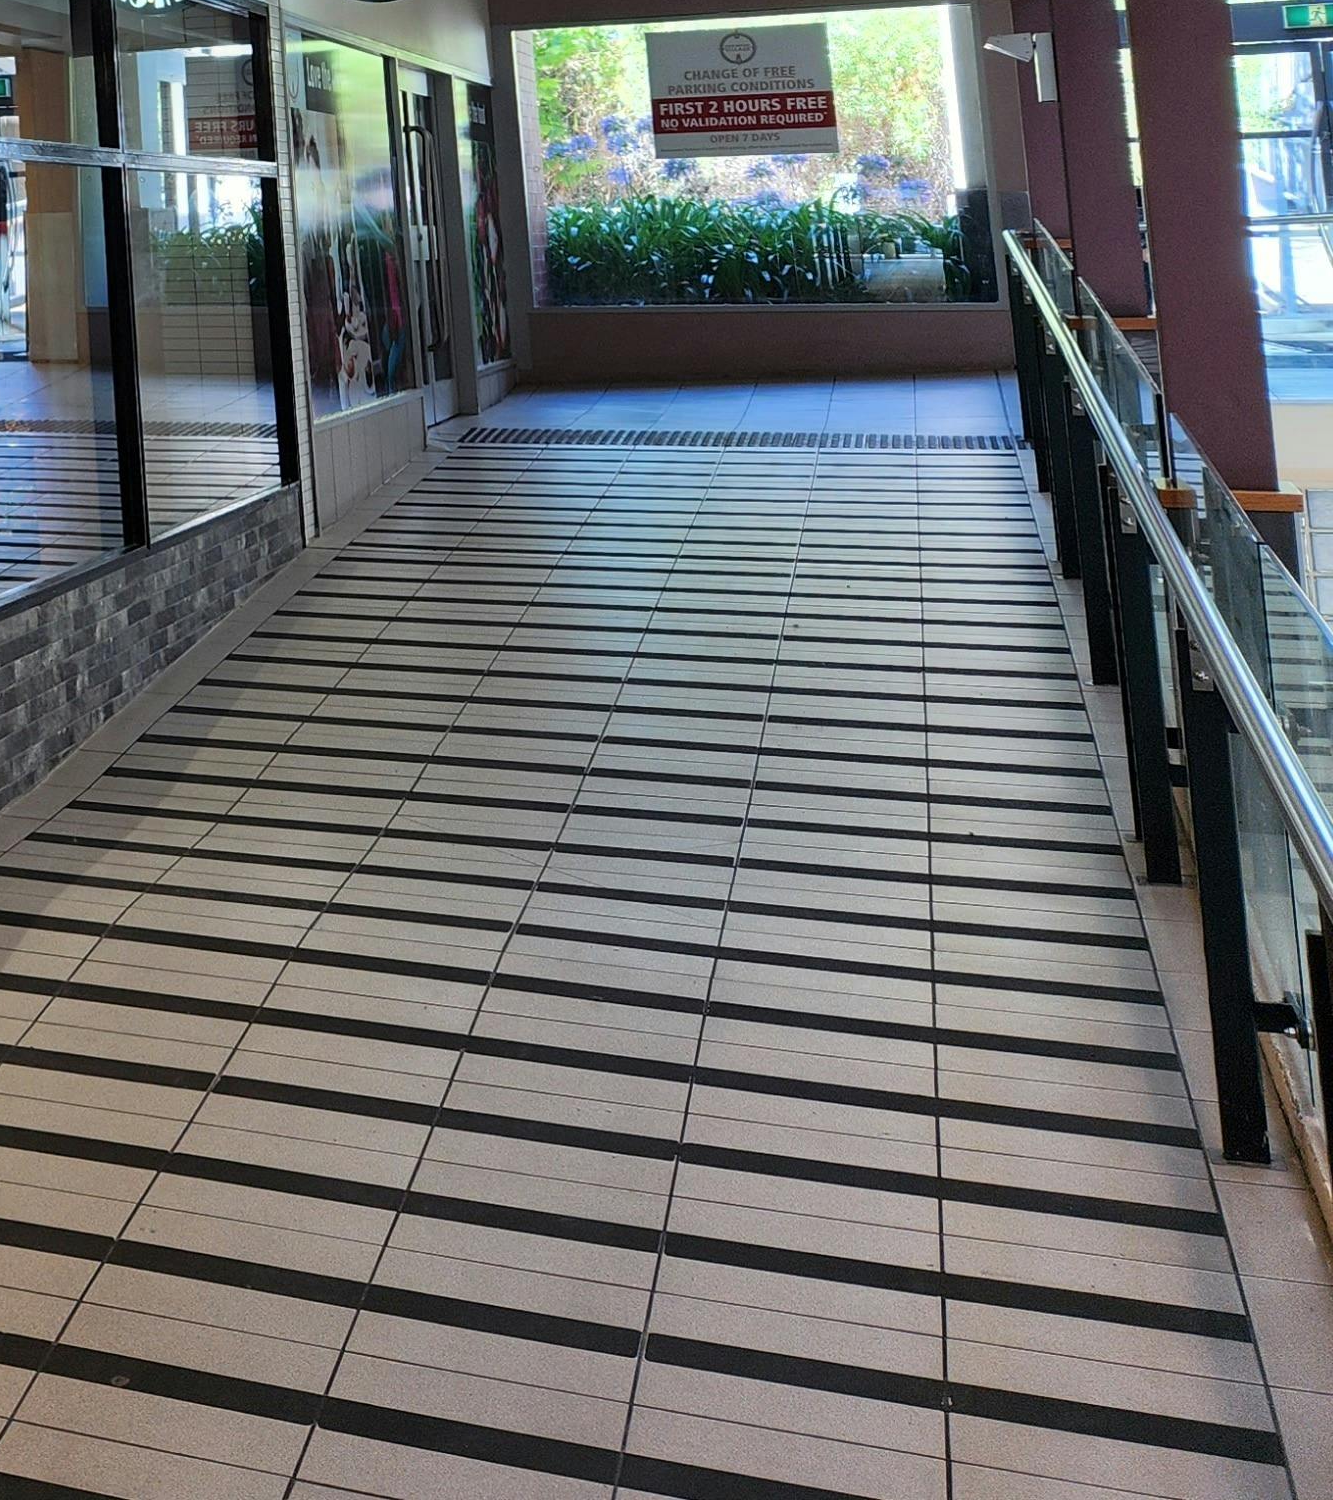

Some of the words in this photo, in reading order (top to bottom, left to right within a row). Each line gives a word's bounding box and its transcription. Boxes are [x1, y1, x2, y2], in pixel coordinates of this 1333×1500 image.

[684, 68, 738, 81] CHANGE
[742, 67, 761, 78] OF
[764, 65, 796, 77] FREE
[668, 82, 726, 96] PARKING
[730, 78, 815, 93] CONDITIONS
[659, 101, 704, 116] FIRST
[708, 100, 719, 114] 2
[723, 98, 781, 114] HOURS
[786, 96, 828, 110] FREE
[660, 118, 679, 129] NO
[682, 114, 757, 128] VALIDATION
[709, 133, 739, 144] OPEN
[742, 132, 748, 143] 7
[752, 131, 780, 142] DAYS
